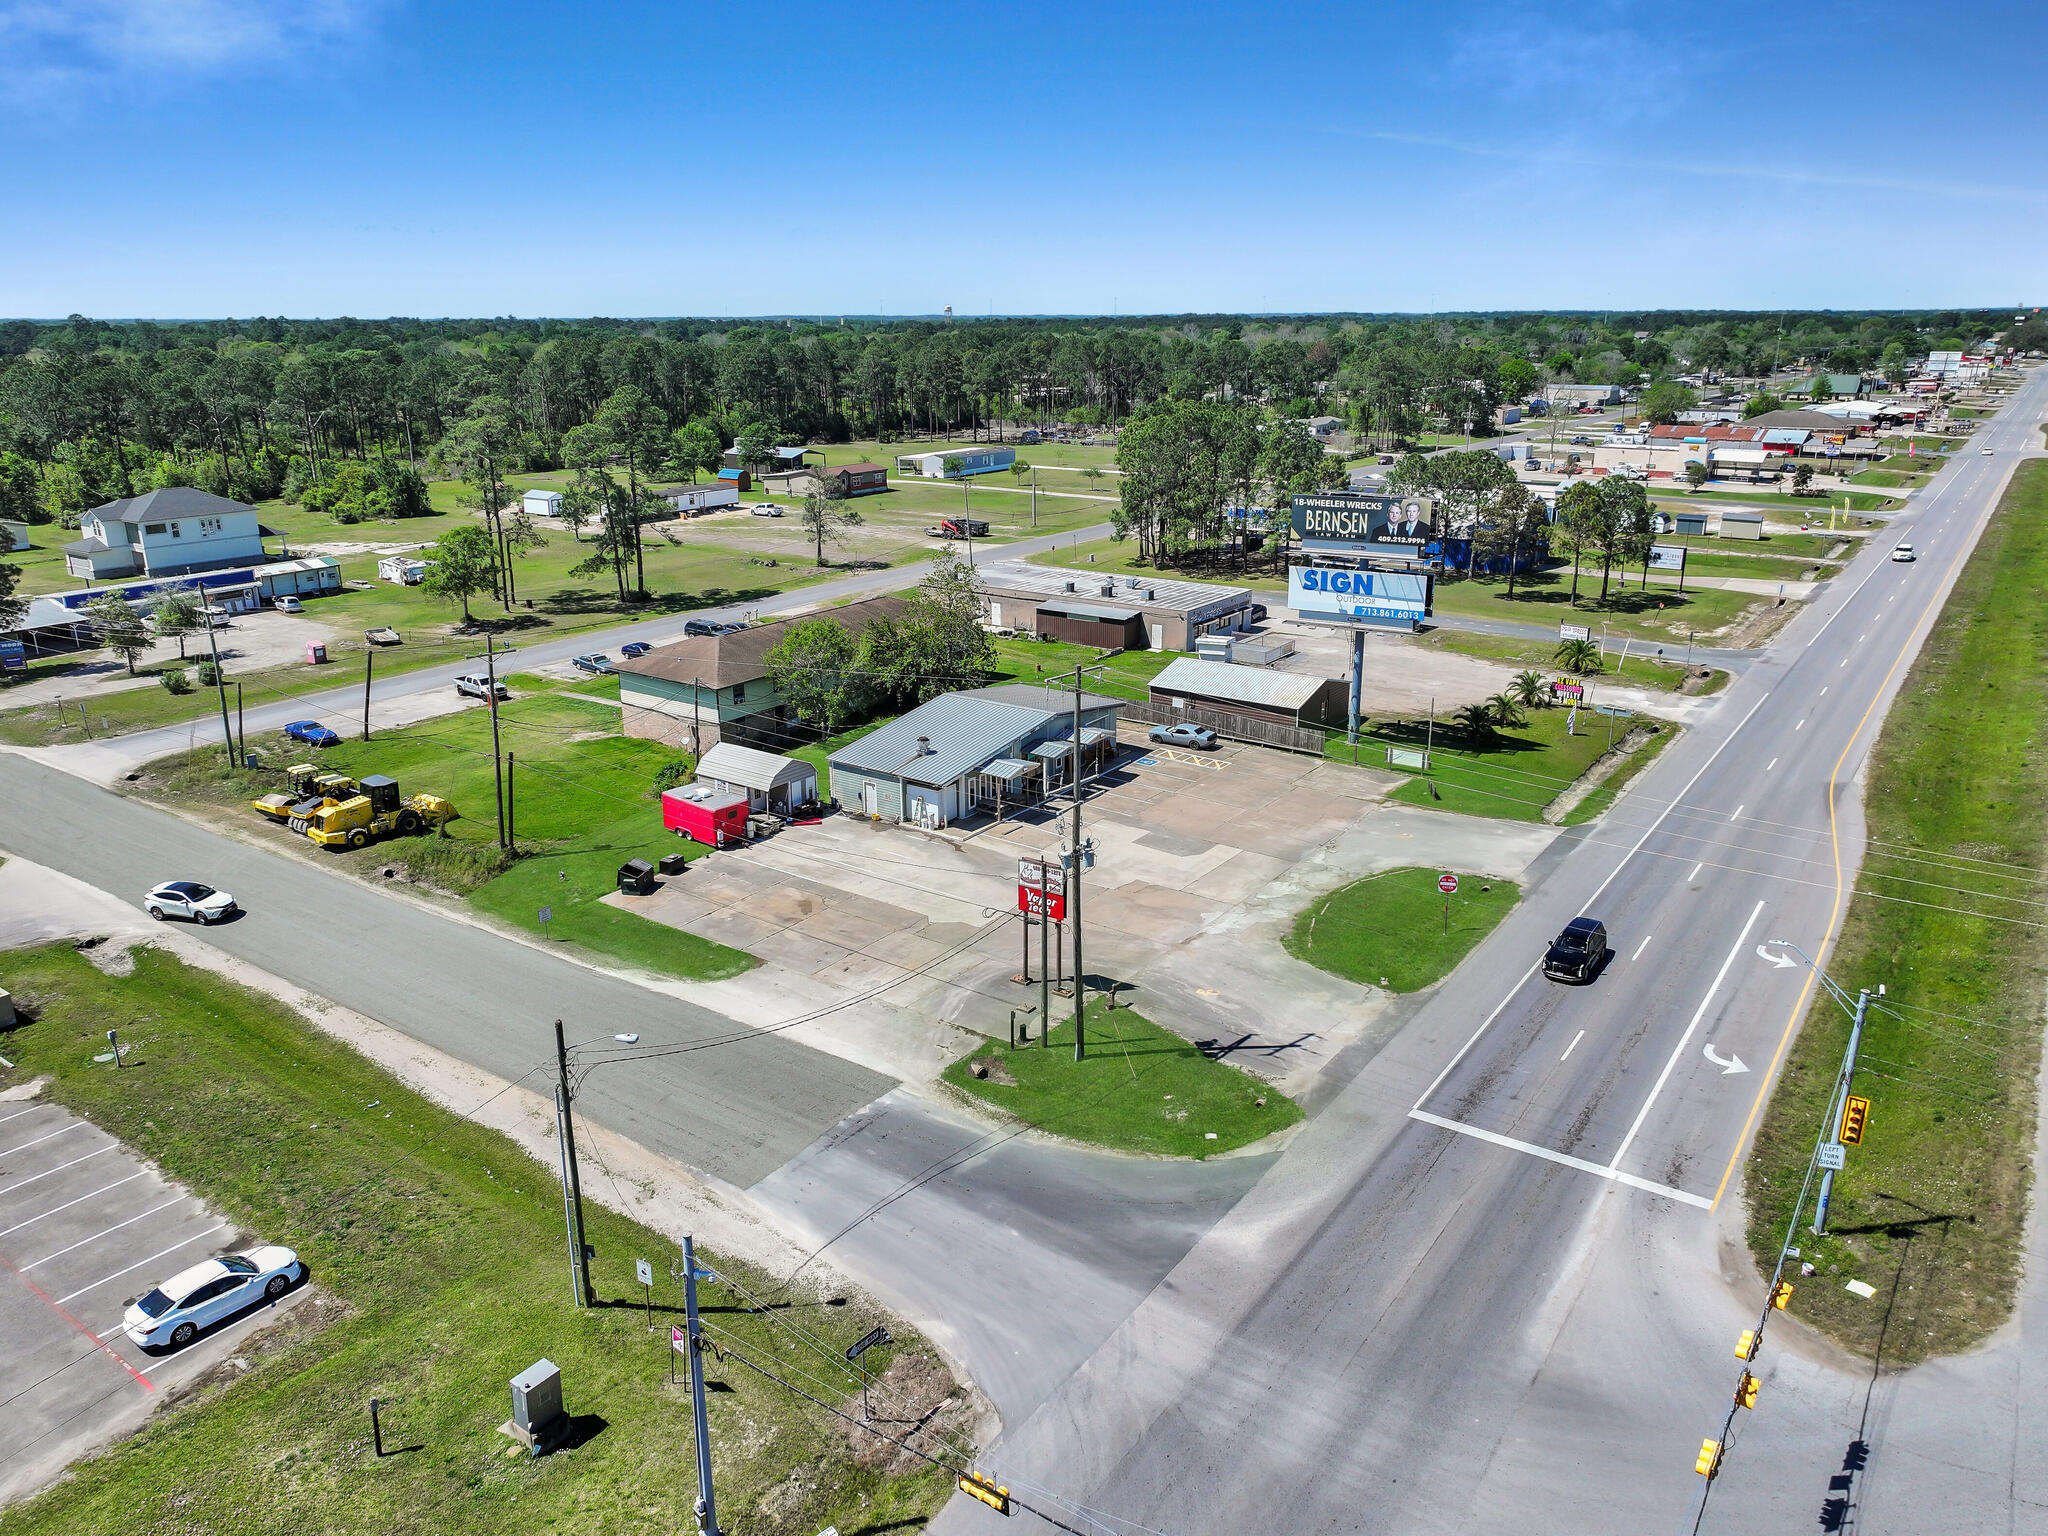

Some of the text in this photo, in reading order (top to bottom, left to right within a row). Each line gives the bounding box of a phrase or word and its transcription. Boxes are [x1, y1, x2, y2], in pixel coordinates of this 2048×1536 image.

[1294, 498, 1383, 510] 18-WHEELER WRECKS
[1305, 510, 1368, 534] BERNSEN
[1377, 535, 1426, 544] 409.212.9994
[1303, 569, 1374, 595] SIGN
[1336, 594, 1376, 605] OUTDOOR
[1361, 607, 1419, 619] 713.861.6013
[1819, 1159, 1841, 1167] SIGNAL
